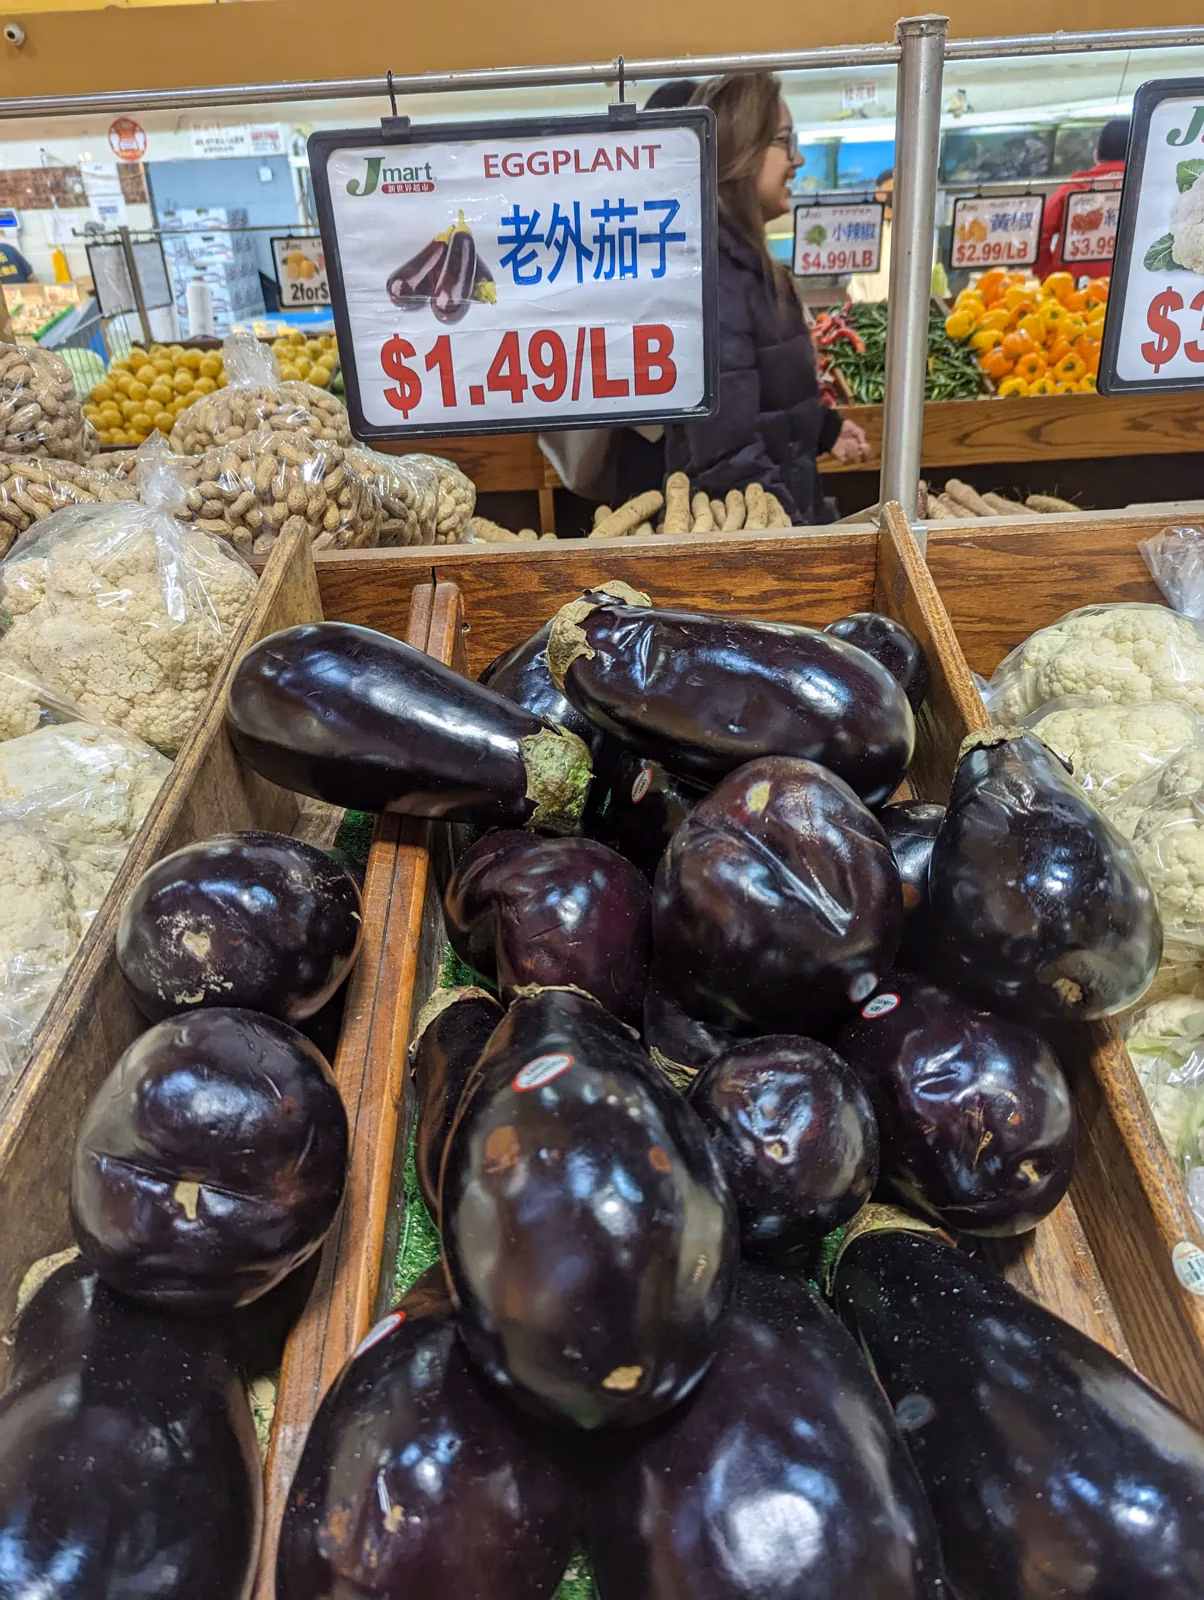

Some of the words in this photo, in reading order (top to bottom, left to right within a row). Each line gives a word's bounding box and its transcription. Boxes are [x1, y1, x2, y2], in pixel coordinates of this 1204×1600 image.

[483, 145, 662, 180] EGGPLANT
[497, 198, 686, 285] 老外茄子
[956, 240, 1028, 263] $2.99/LB
[801, 250, 874, 271] $4.99/LB
[380, 324, 678, 420] $1.49/LB
